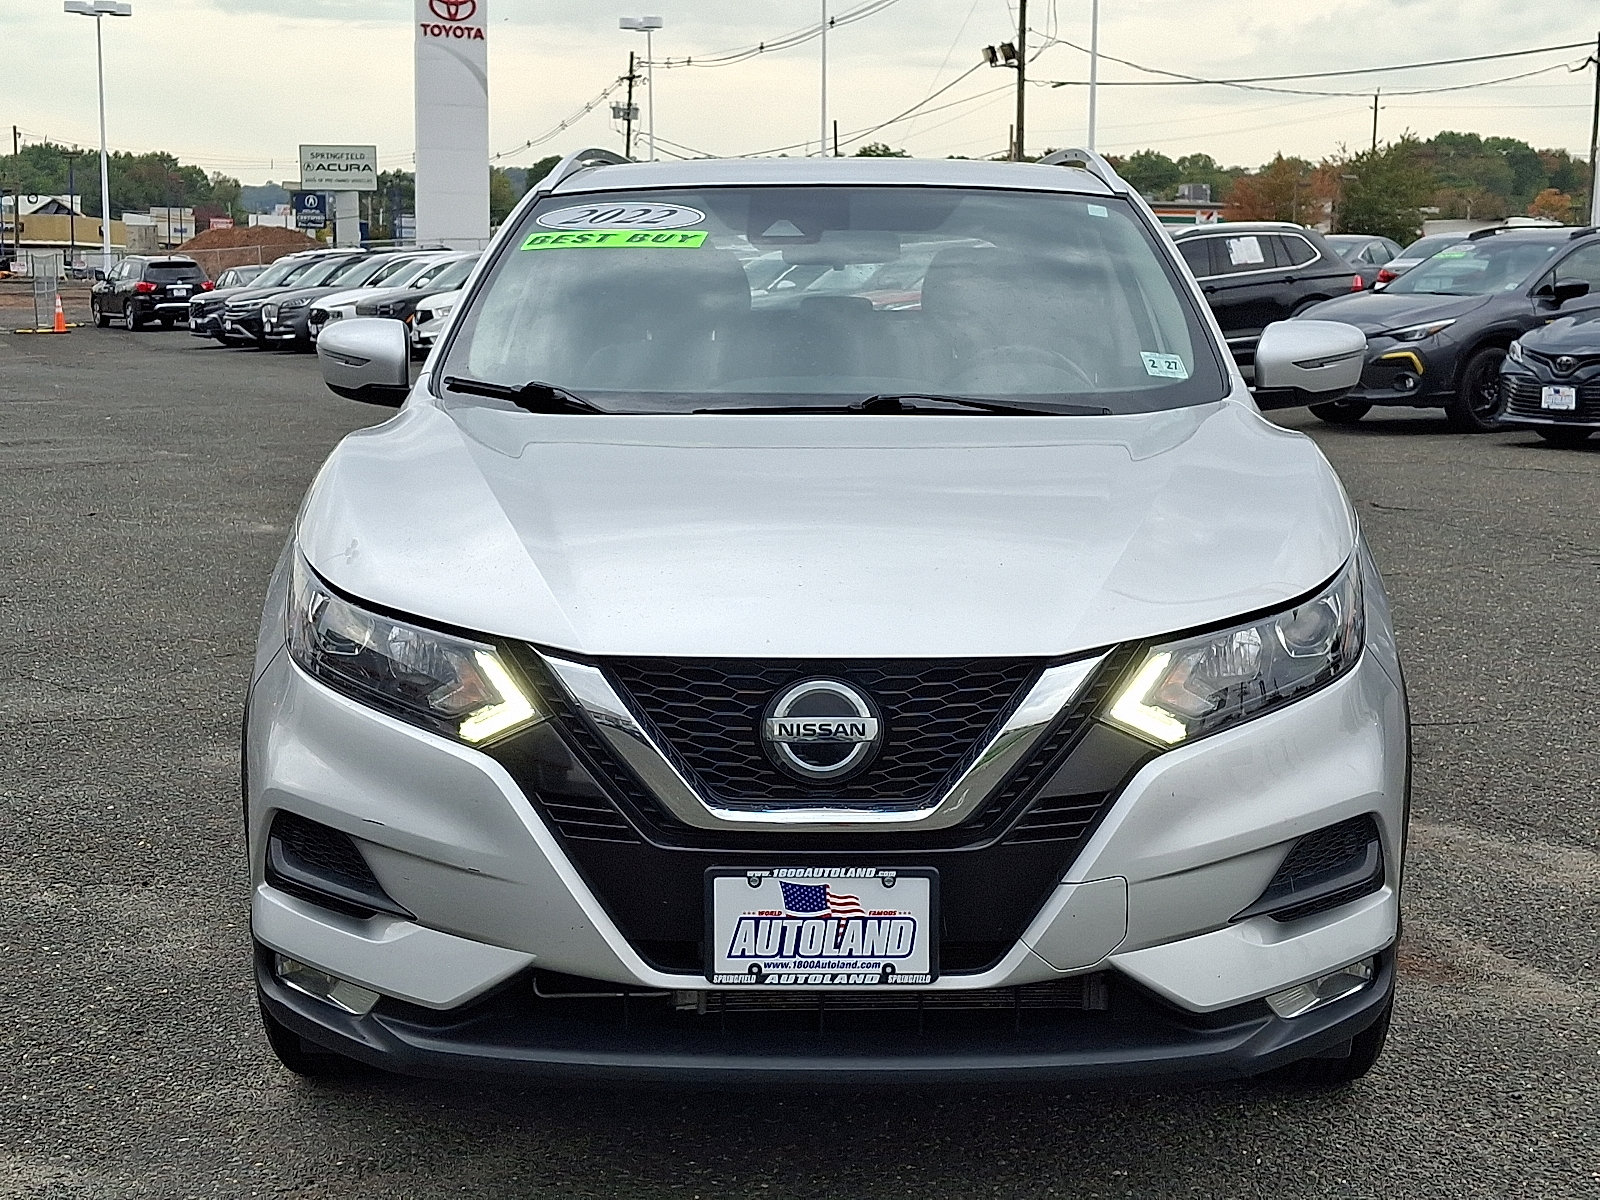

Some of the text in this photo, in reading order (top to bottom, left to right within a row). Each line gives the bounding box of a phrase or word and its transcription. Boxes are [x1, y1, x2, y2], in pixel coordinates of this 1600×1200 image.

[420, 23, 484, 40] TOYOTA
[310, 152, 365, 160] SPRINGFIELD
[315, 162, 373, 172] ACURA
[559, 208, 678, 225] 2022
[527, 233, 701, 246] BEST BUY
[1149, 359, 1178, 370] 2 27
[778, 723, 866, 737] NISSAN
[747, 867, 896, 878] www.1800AUTOLAND.com
[728, 917, 917, 958] AUTOLAND
[763, 960, 881, 970] www.1800Autoland.com
[713, 974, 931, 984] SPRINGFIELD AUTOLAND SPRINGFIELD
